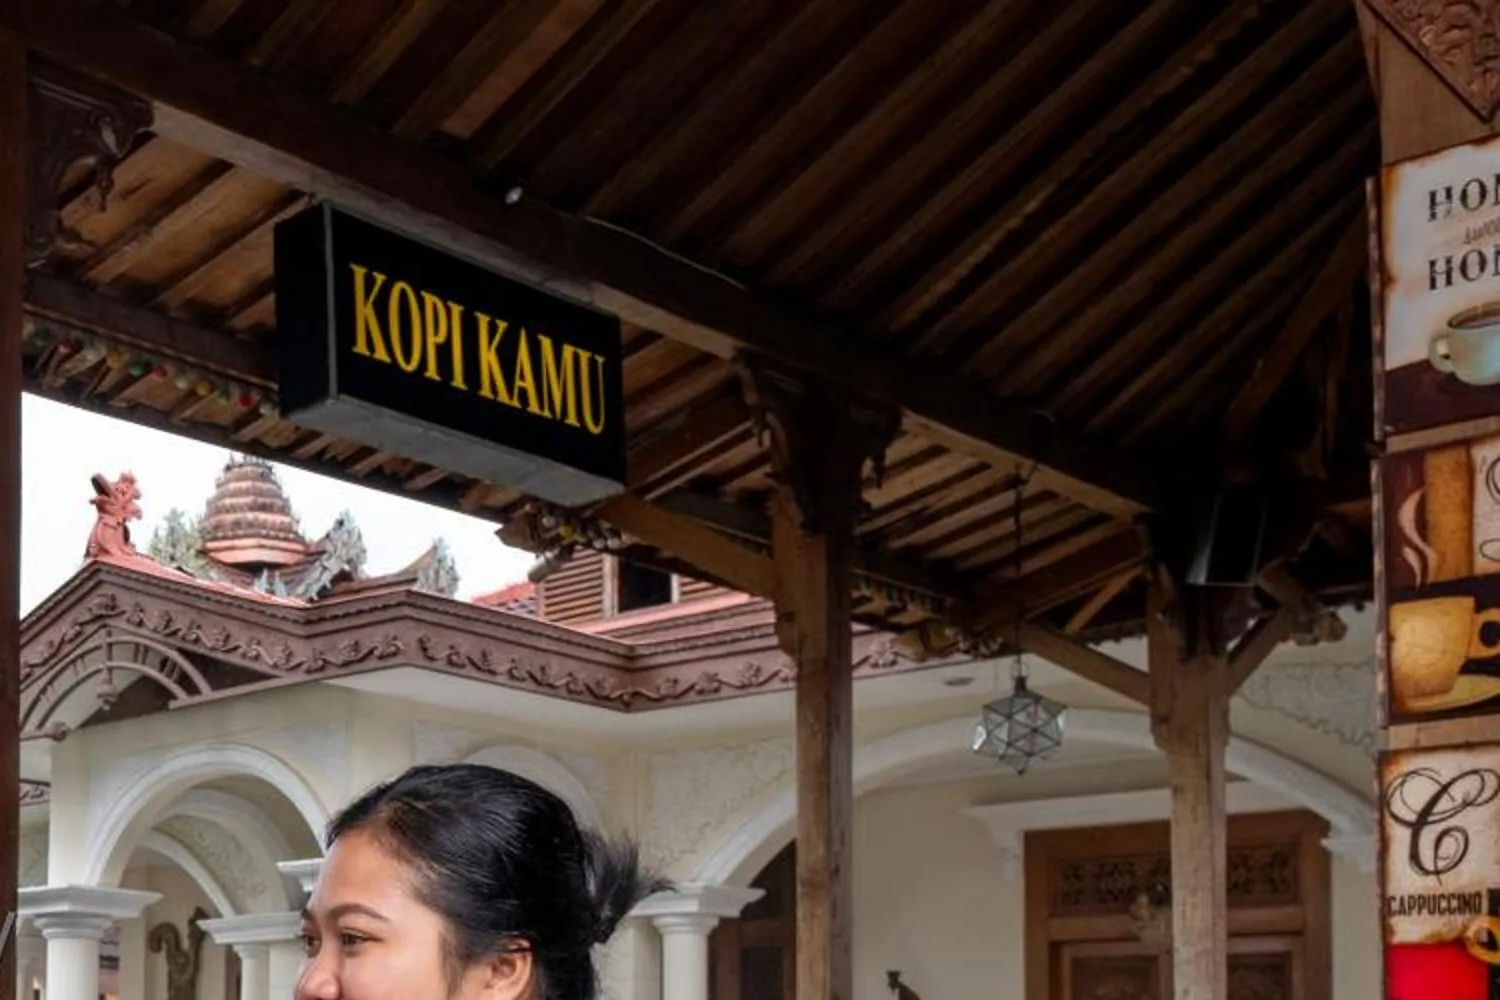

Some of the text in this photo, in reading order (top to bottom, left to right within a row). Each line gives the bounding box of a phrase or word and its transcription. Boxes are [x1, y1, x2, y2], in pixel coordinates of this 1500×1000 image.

[349, 263, 605, 435] KOPI KAMU
[1387, 890, 1482, 917] CAPPUCCINO
